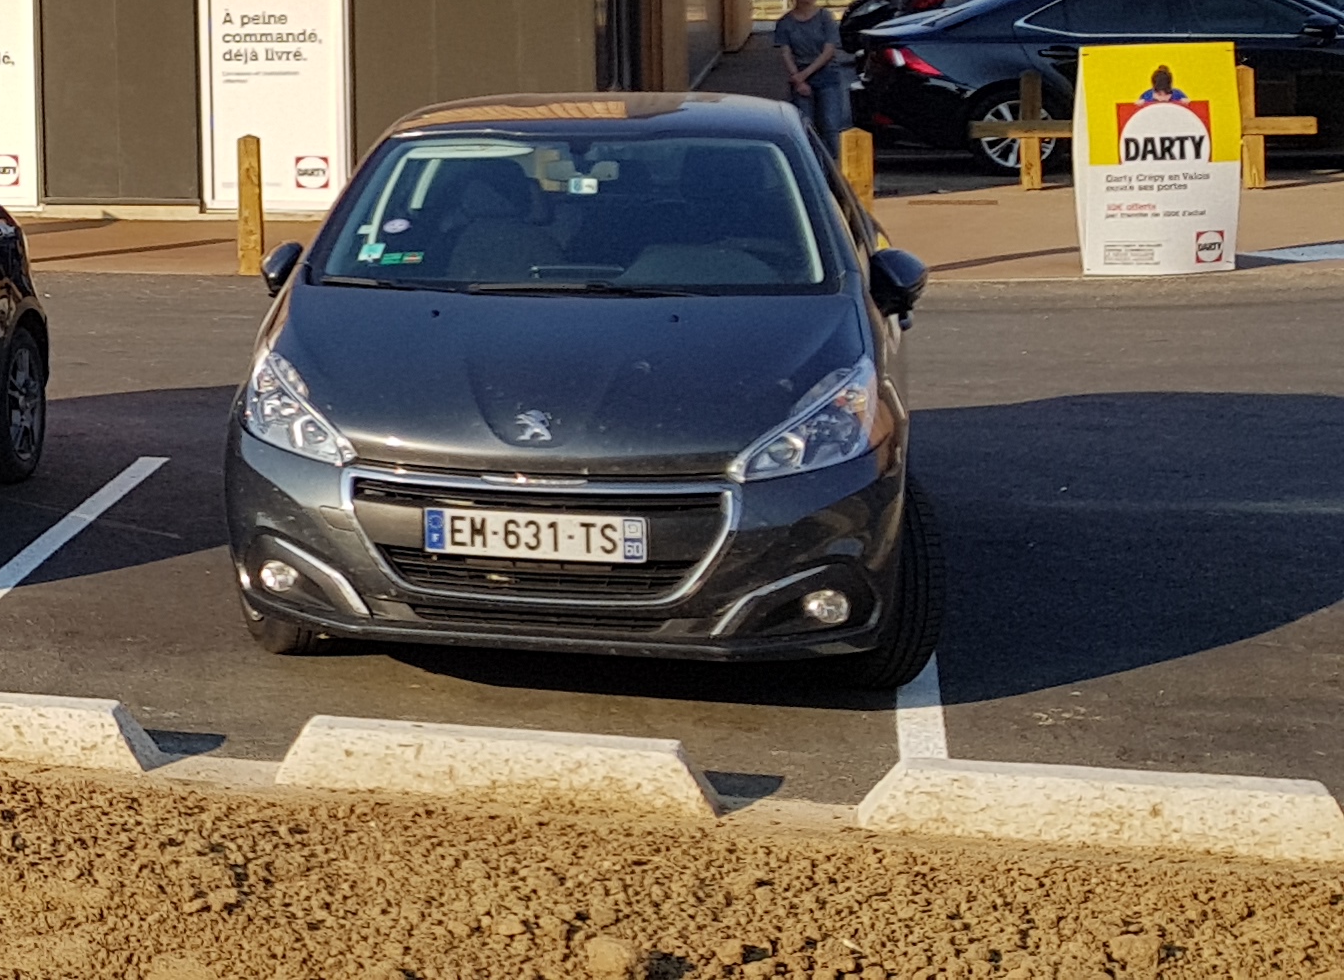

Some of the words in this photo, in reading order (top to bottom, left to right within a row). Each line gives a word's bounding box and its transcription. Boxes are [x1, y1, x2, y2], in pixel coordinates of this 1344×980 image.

[222, 8, 234, 25] À
[240, 11, 288, 28] peine
[222, 28, 323, 45] commandé,
[222, 47, 259, 65] déjà
[265, 47, 308, 61] livré.
[1124, 135, 1206, 161] DARTY
[297, 168, 326, 176] DARTY
[1105, 174, 1132, 184] Darty
[1157, 183, 1188, 192] portes
[1197, 242, 1223, 252] DARTY
[450, 515, 618, 554] EM-631-TS
[624, 541, 642, 557] 60
